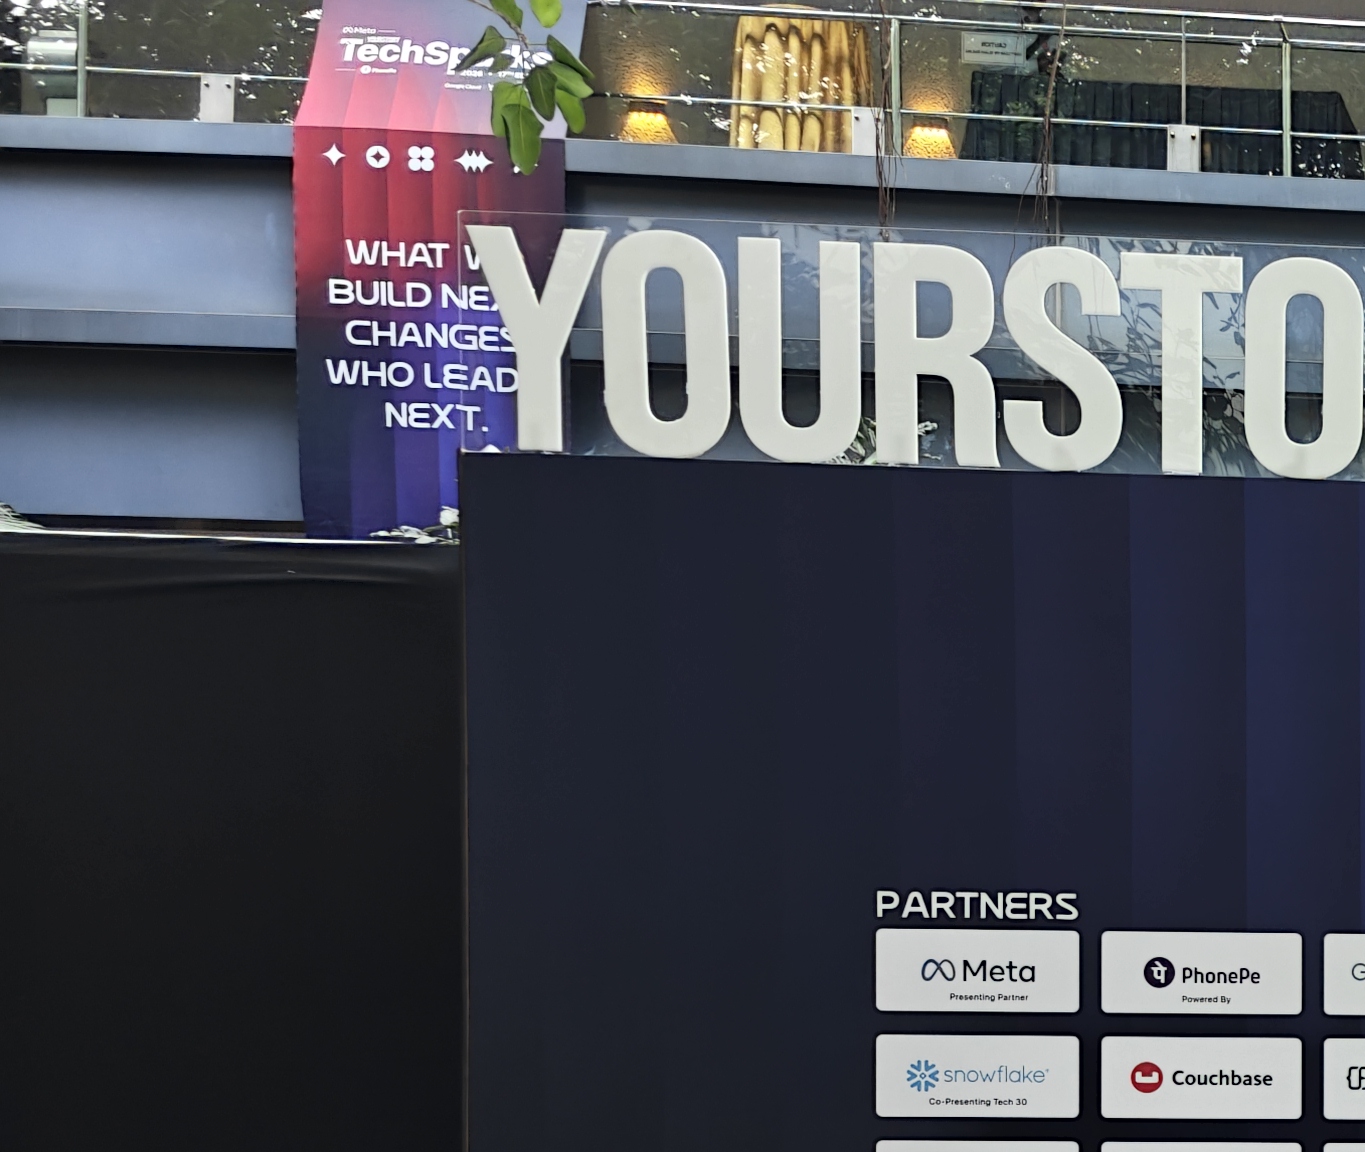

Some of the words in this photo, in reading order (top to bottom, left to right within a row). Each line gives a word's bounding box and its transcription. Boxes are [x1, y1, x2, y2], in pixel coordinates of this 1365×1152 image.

[345, 239, 450, 268] WHAT
[328, 278, 432, 308] BUILD
[384, 402, 489, 432] NEXT.
[876, 890, 1079, 920] PARTNERS
[962, 959, 1036, 983] Meta
[1182, 967, 1261, 985] PhonePe
[950, 993, 996, 1002] Presenting
[998, 993, 1028, 1002] Partner
[1182, 995, 1218, 1004] Powered
[1220, 995, 1232, 1005] By
[944, 1065, 1046, 1084] snowflake
[1172, 1070, 1273, 1086] Couchbase
[928, 1098, 991, 1107] Co-Presenting
[994, 1098, 1014, 1106] Tech
[1016, 1098, 1028, 1106] 30
